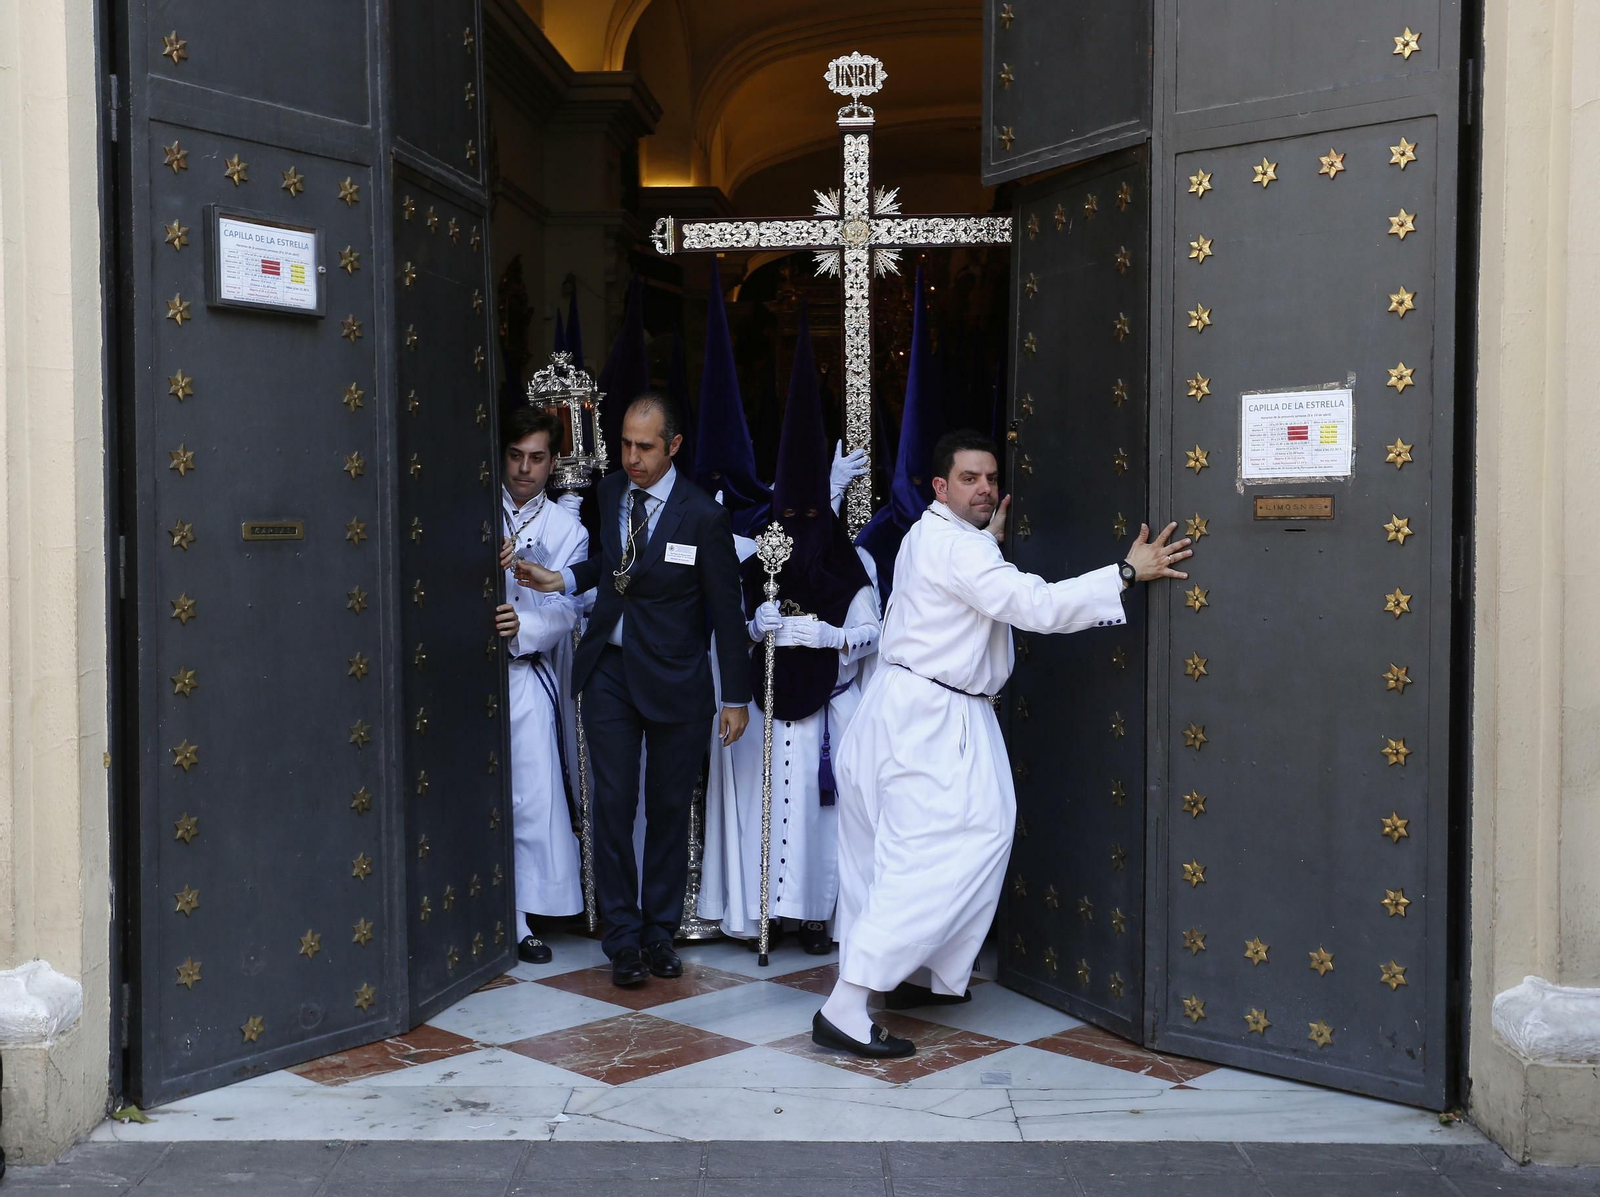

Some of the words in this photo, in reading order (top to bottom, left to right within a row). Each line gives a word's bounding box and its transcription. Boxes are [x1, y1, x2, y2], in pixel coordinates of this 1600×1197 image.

[838, 64, 873, 87] INRI
[223, 229, 254, 241] CAPILLA
[255, 234, 265, 244] DE
[266, 236, 275, 245] LA
[277, 238, 310, 251] ESTRELLA
[1248, 402, 1280, 412] CAPILLA
[1281, 402, 1292, 410] DE
[1294, 402, 1304, 410] LA
[1306, 399, 1345, 409] ESTRELLA
[1265, 503, 1323, 511] LIMOSNAS
